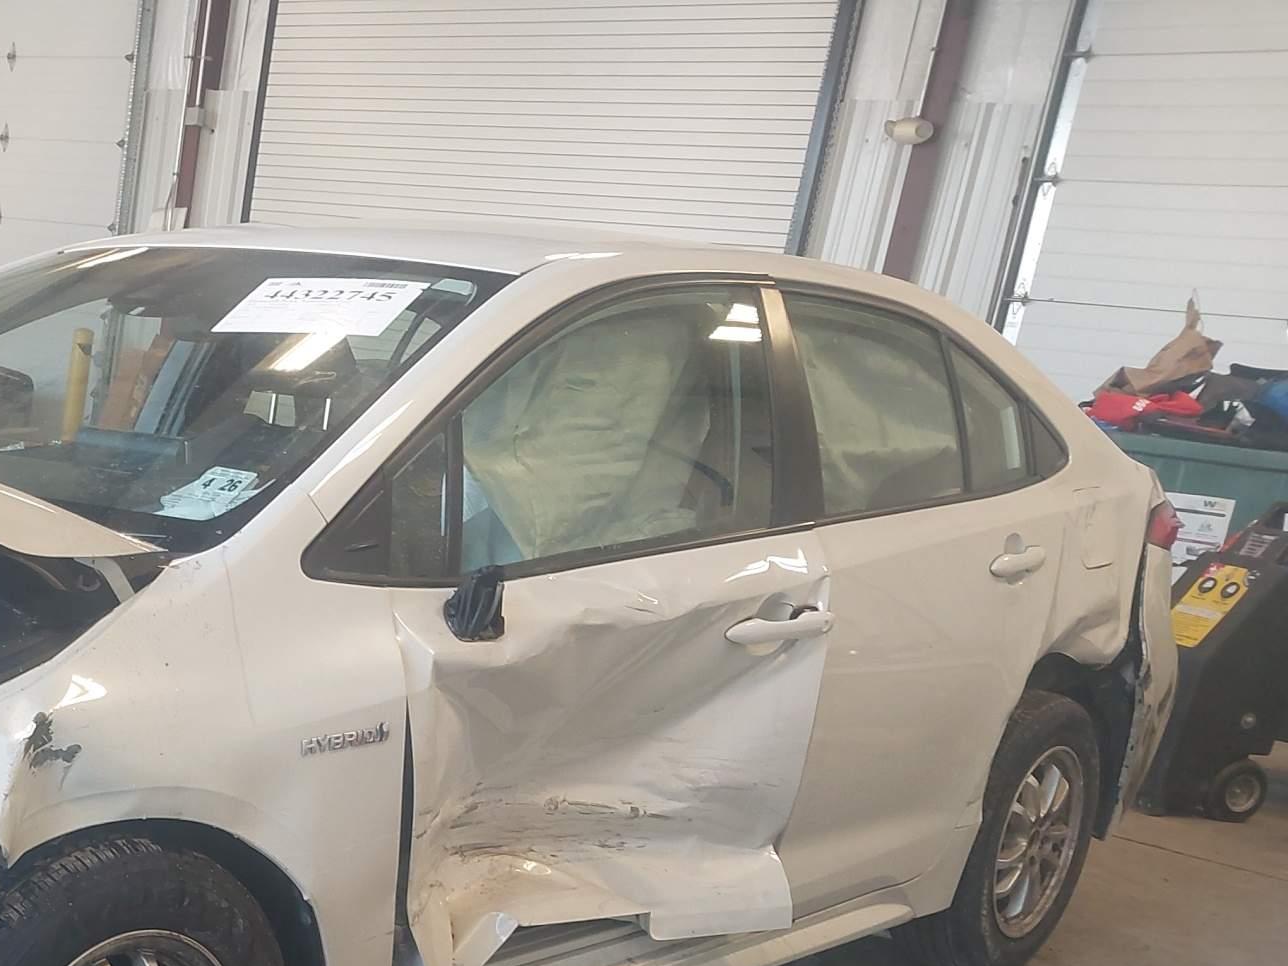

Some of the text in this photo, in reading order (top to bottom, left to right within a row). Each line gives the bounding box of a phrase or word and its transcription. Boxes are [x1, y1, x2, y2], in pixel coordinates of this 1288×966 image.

[264, 289, 398, 302] 44322745
[201, 477, 243, 493] 4 26
